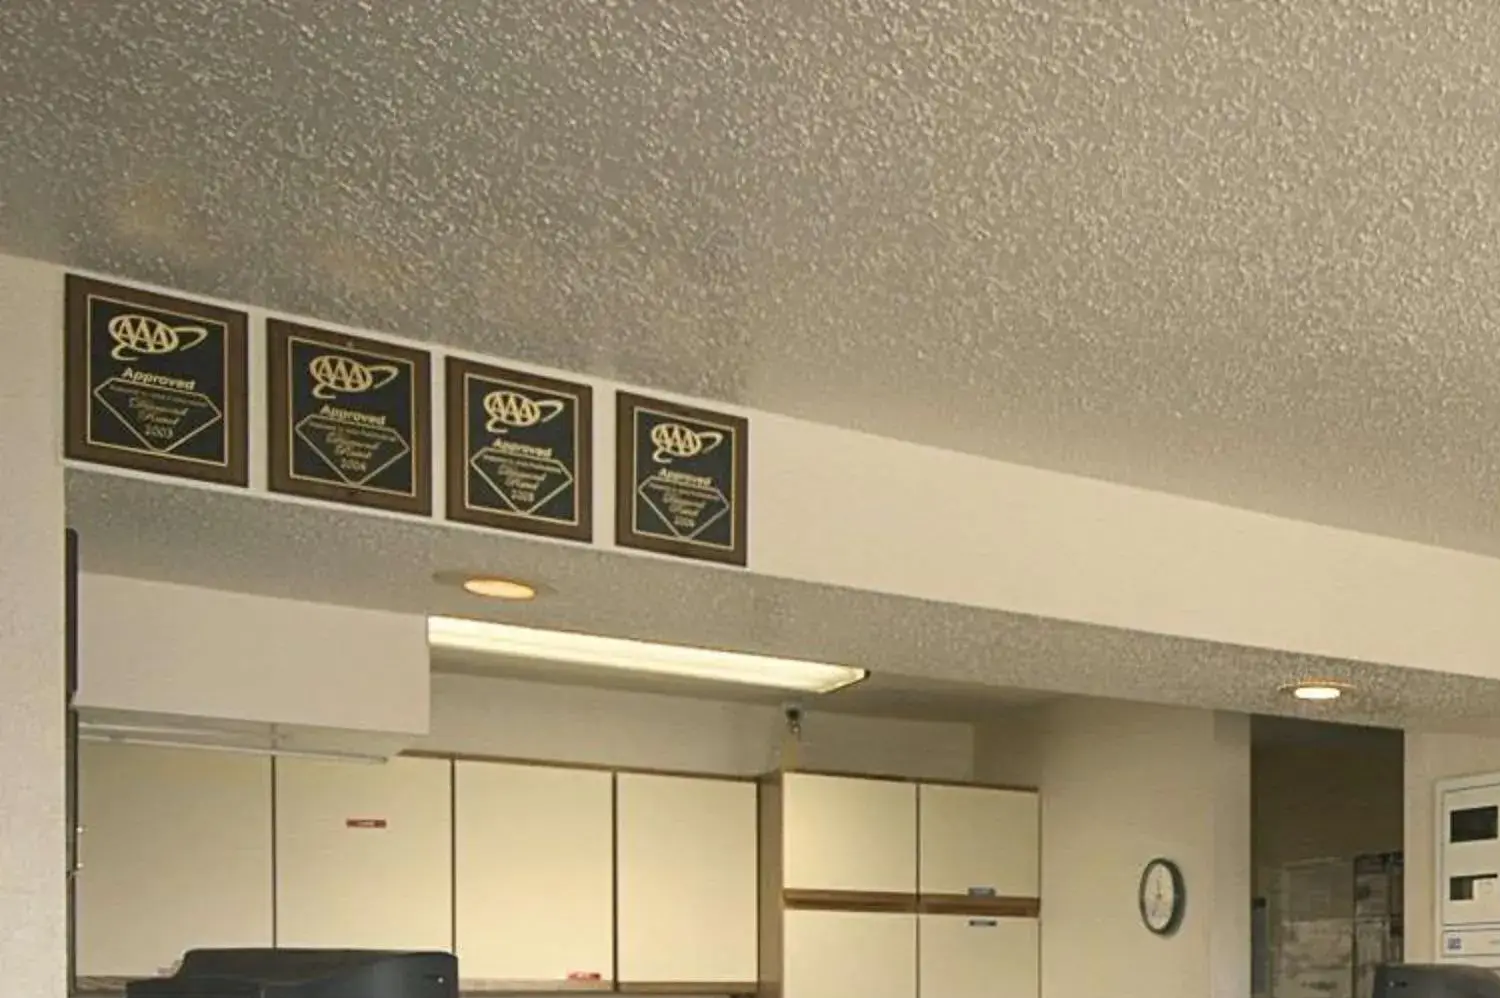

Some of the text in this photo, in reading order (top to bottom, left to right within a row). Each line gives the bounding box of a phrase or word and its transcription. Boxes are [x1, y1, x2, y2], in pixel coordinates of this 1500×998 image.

[114, 317, 173, 351] AAA
[121, 367, 197, 391] Approved
[314, 357, 369, 391] AAA
[320, 404, 387, 427] Approved
[487, 393, 538, 426] AAA
[654, 424, 699, 456] AAA
